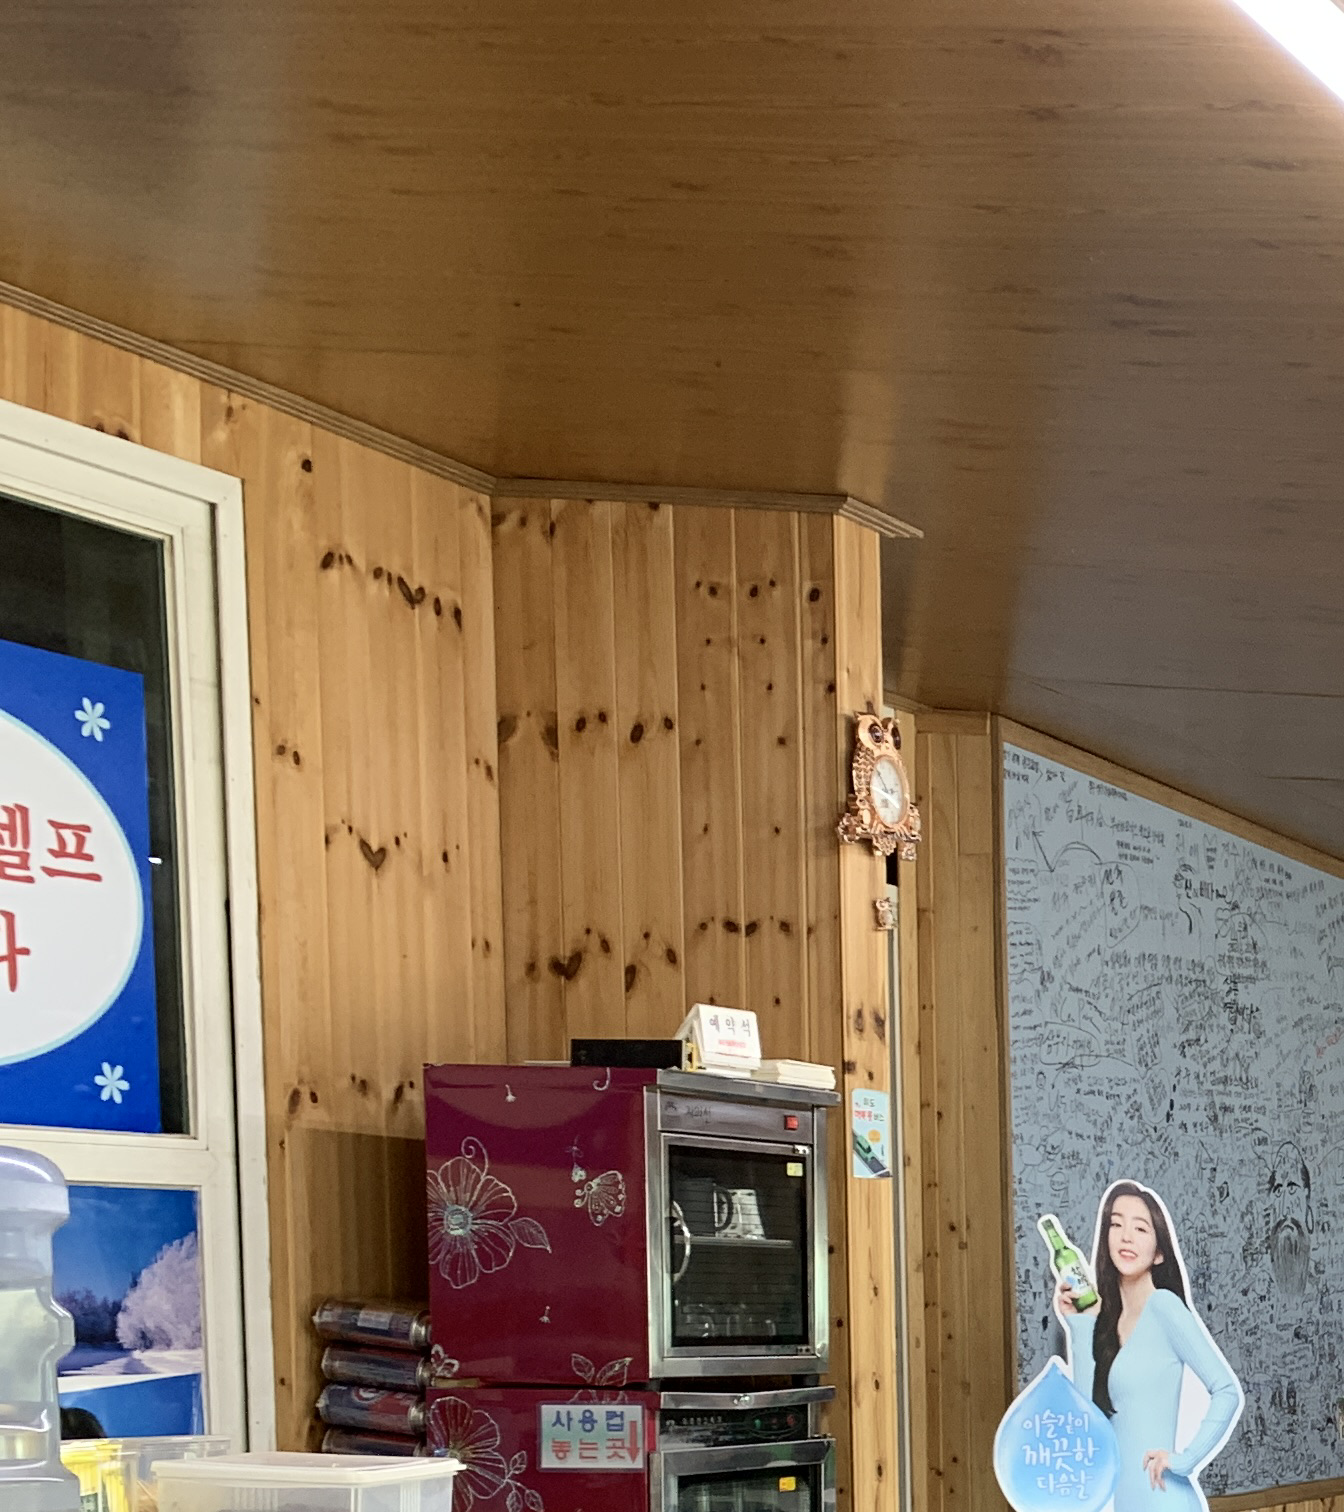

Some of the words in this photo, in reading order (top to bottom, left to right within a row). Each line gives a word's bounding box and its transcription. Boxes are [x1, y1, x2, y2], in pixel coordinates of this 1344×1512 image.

[1023, 1408, 1089, 1439] 이슬같이
[1022, 1436, 1100, 1473] 깨끗한
[1036, 1470, 1094, 1500] 다음날
